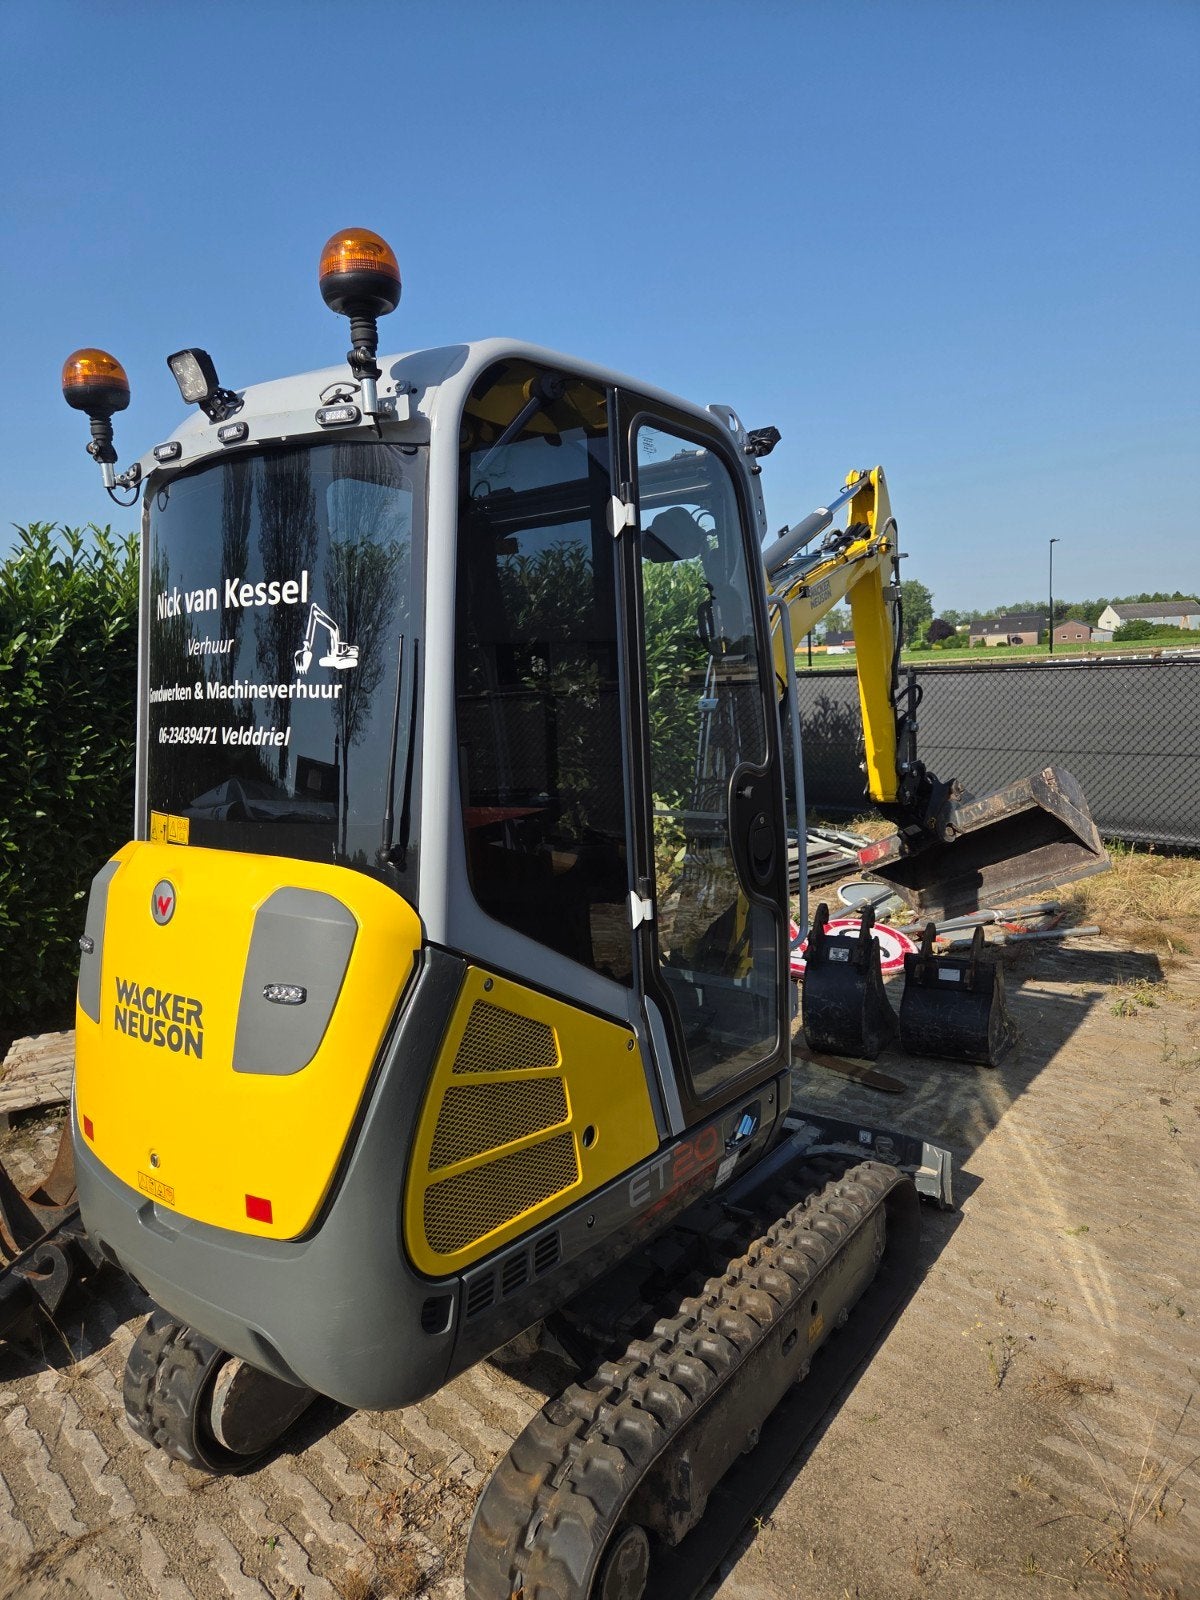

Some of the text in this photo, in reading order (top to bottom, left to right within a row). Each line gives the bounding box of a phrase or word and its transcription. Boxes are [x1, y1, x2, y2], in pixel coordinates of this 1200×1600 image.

[157, 570, 308, 621] Nick van Kessel
[188, 635, 235, 656] Verhuur
[194, 681, 204, 700] &
[206, 678, 342, 700] Machineverhuur
[158, 725, 291, 747] 06-23439471 Velddriel
[115, 976, 204, 1029] WACKER
[114, 1004, 204, 1060] NEUSON
[629, 1125, 718, 1208] ET20
